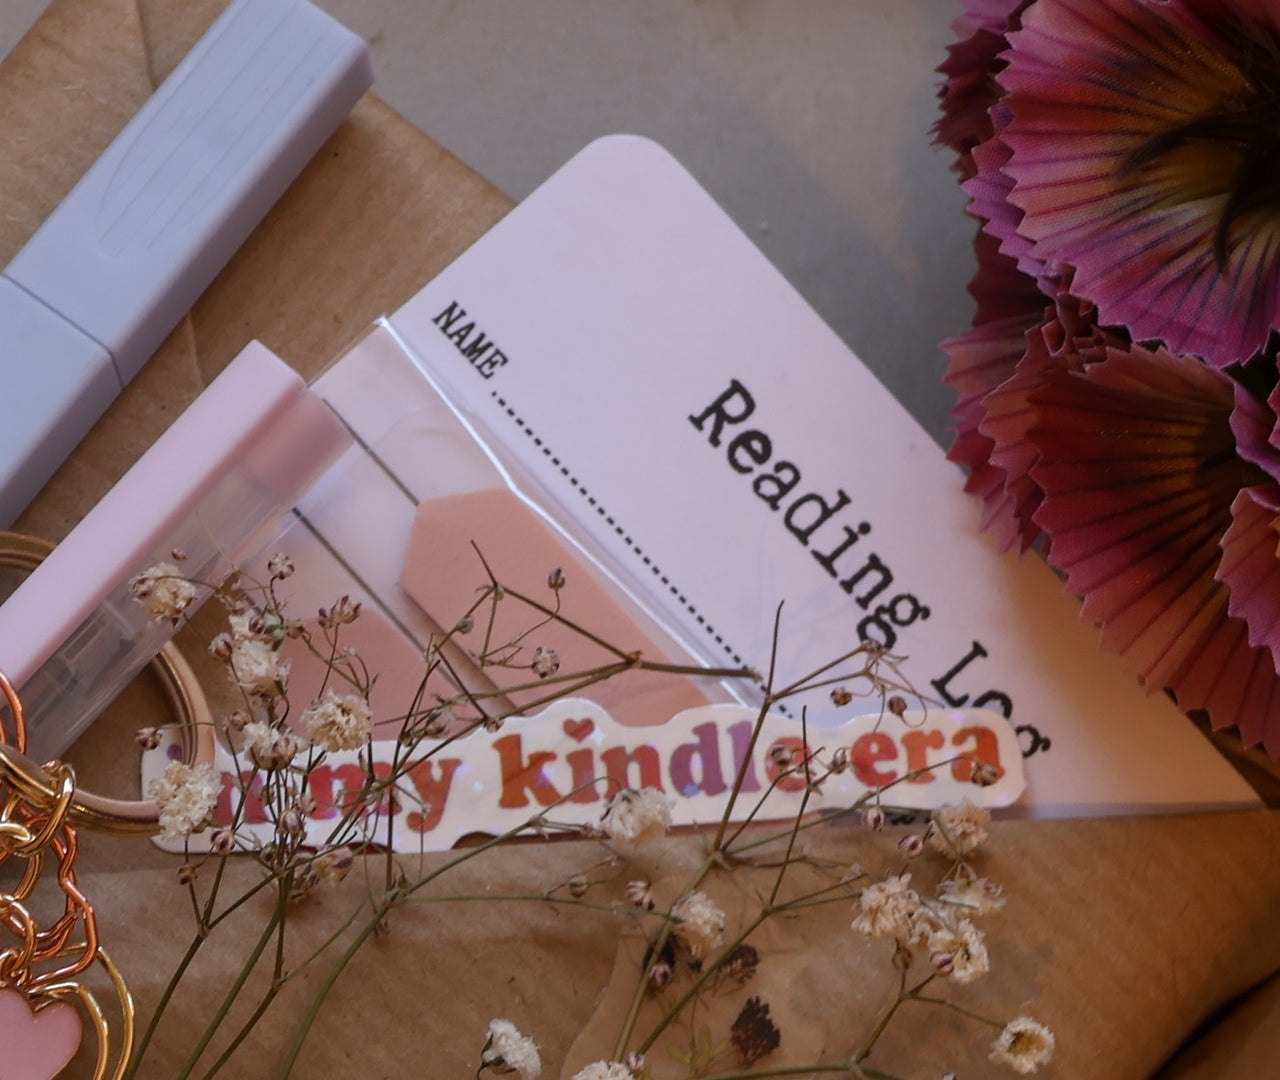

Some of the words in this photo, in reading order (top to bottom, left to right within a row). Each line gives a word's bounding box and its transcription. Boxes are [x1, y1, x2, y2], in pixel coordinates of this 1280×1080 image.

[431, 300, 510, 382] NAME
[689, 378, 931, 651] Reading
[492, 718, 813, 809] kindle
[851, 725, 1007, 789] era
